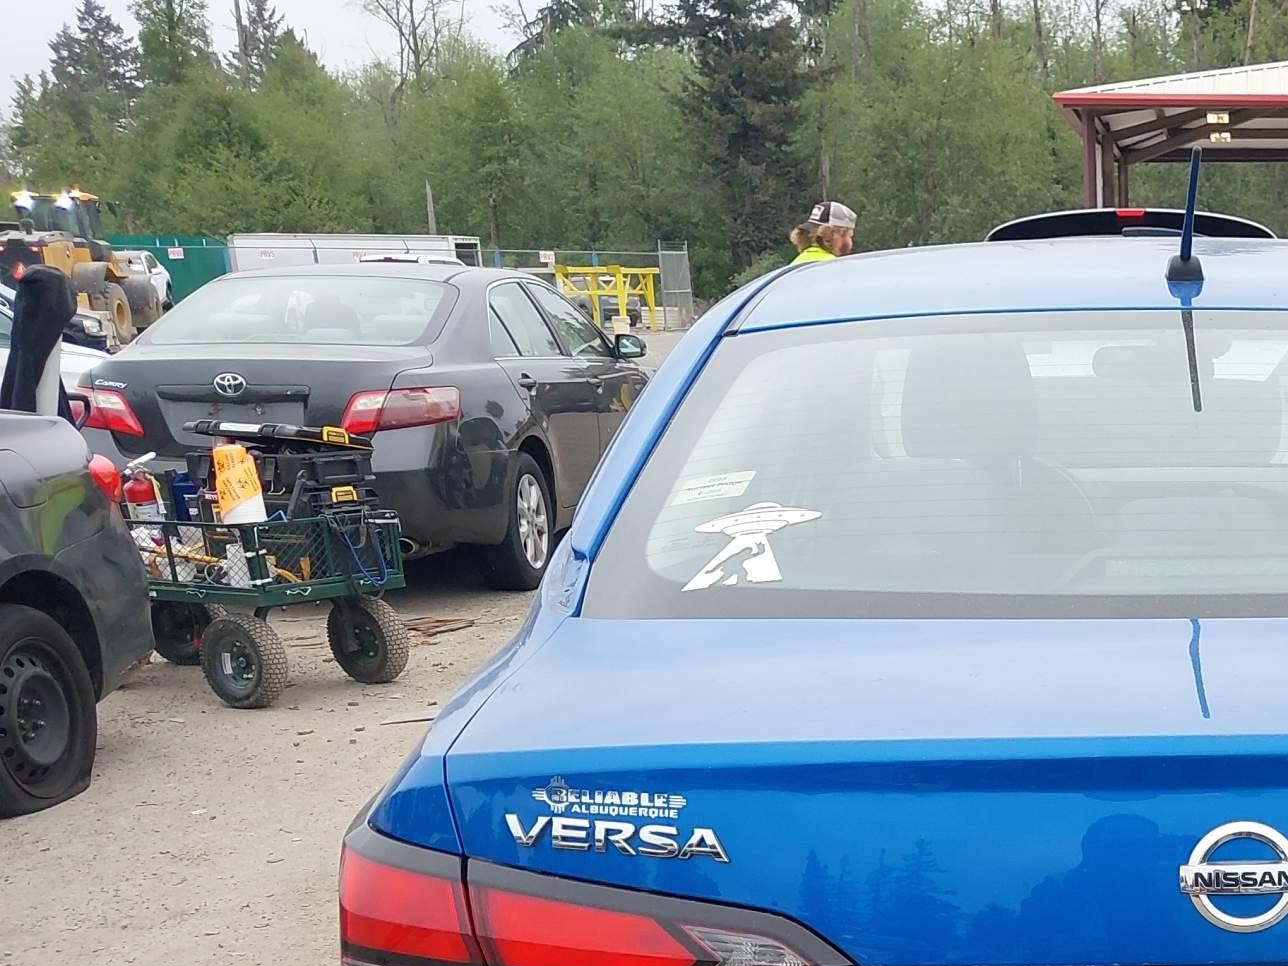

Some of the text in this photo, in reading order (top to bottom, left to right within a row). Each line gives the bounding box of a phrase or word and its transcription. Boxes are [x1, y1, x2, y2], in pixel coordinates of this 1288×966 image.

[550, 787, 670, 808] RELIABLE
[571, 804, 678, 819] ALBUQUERQUE
[505, 814, 729, 863] VERSA
